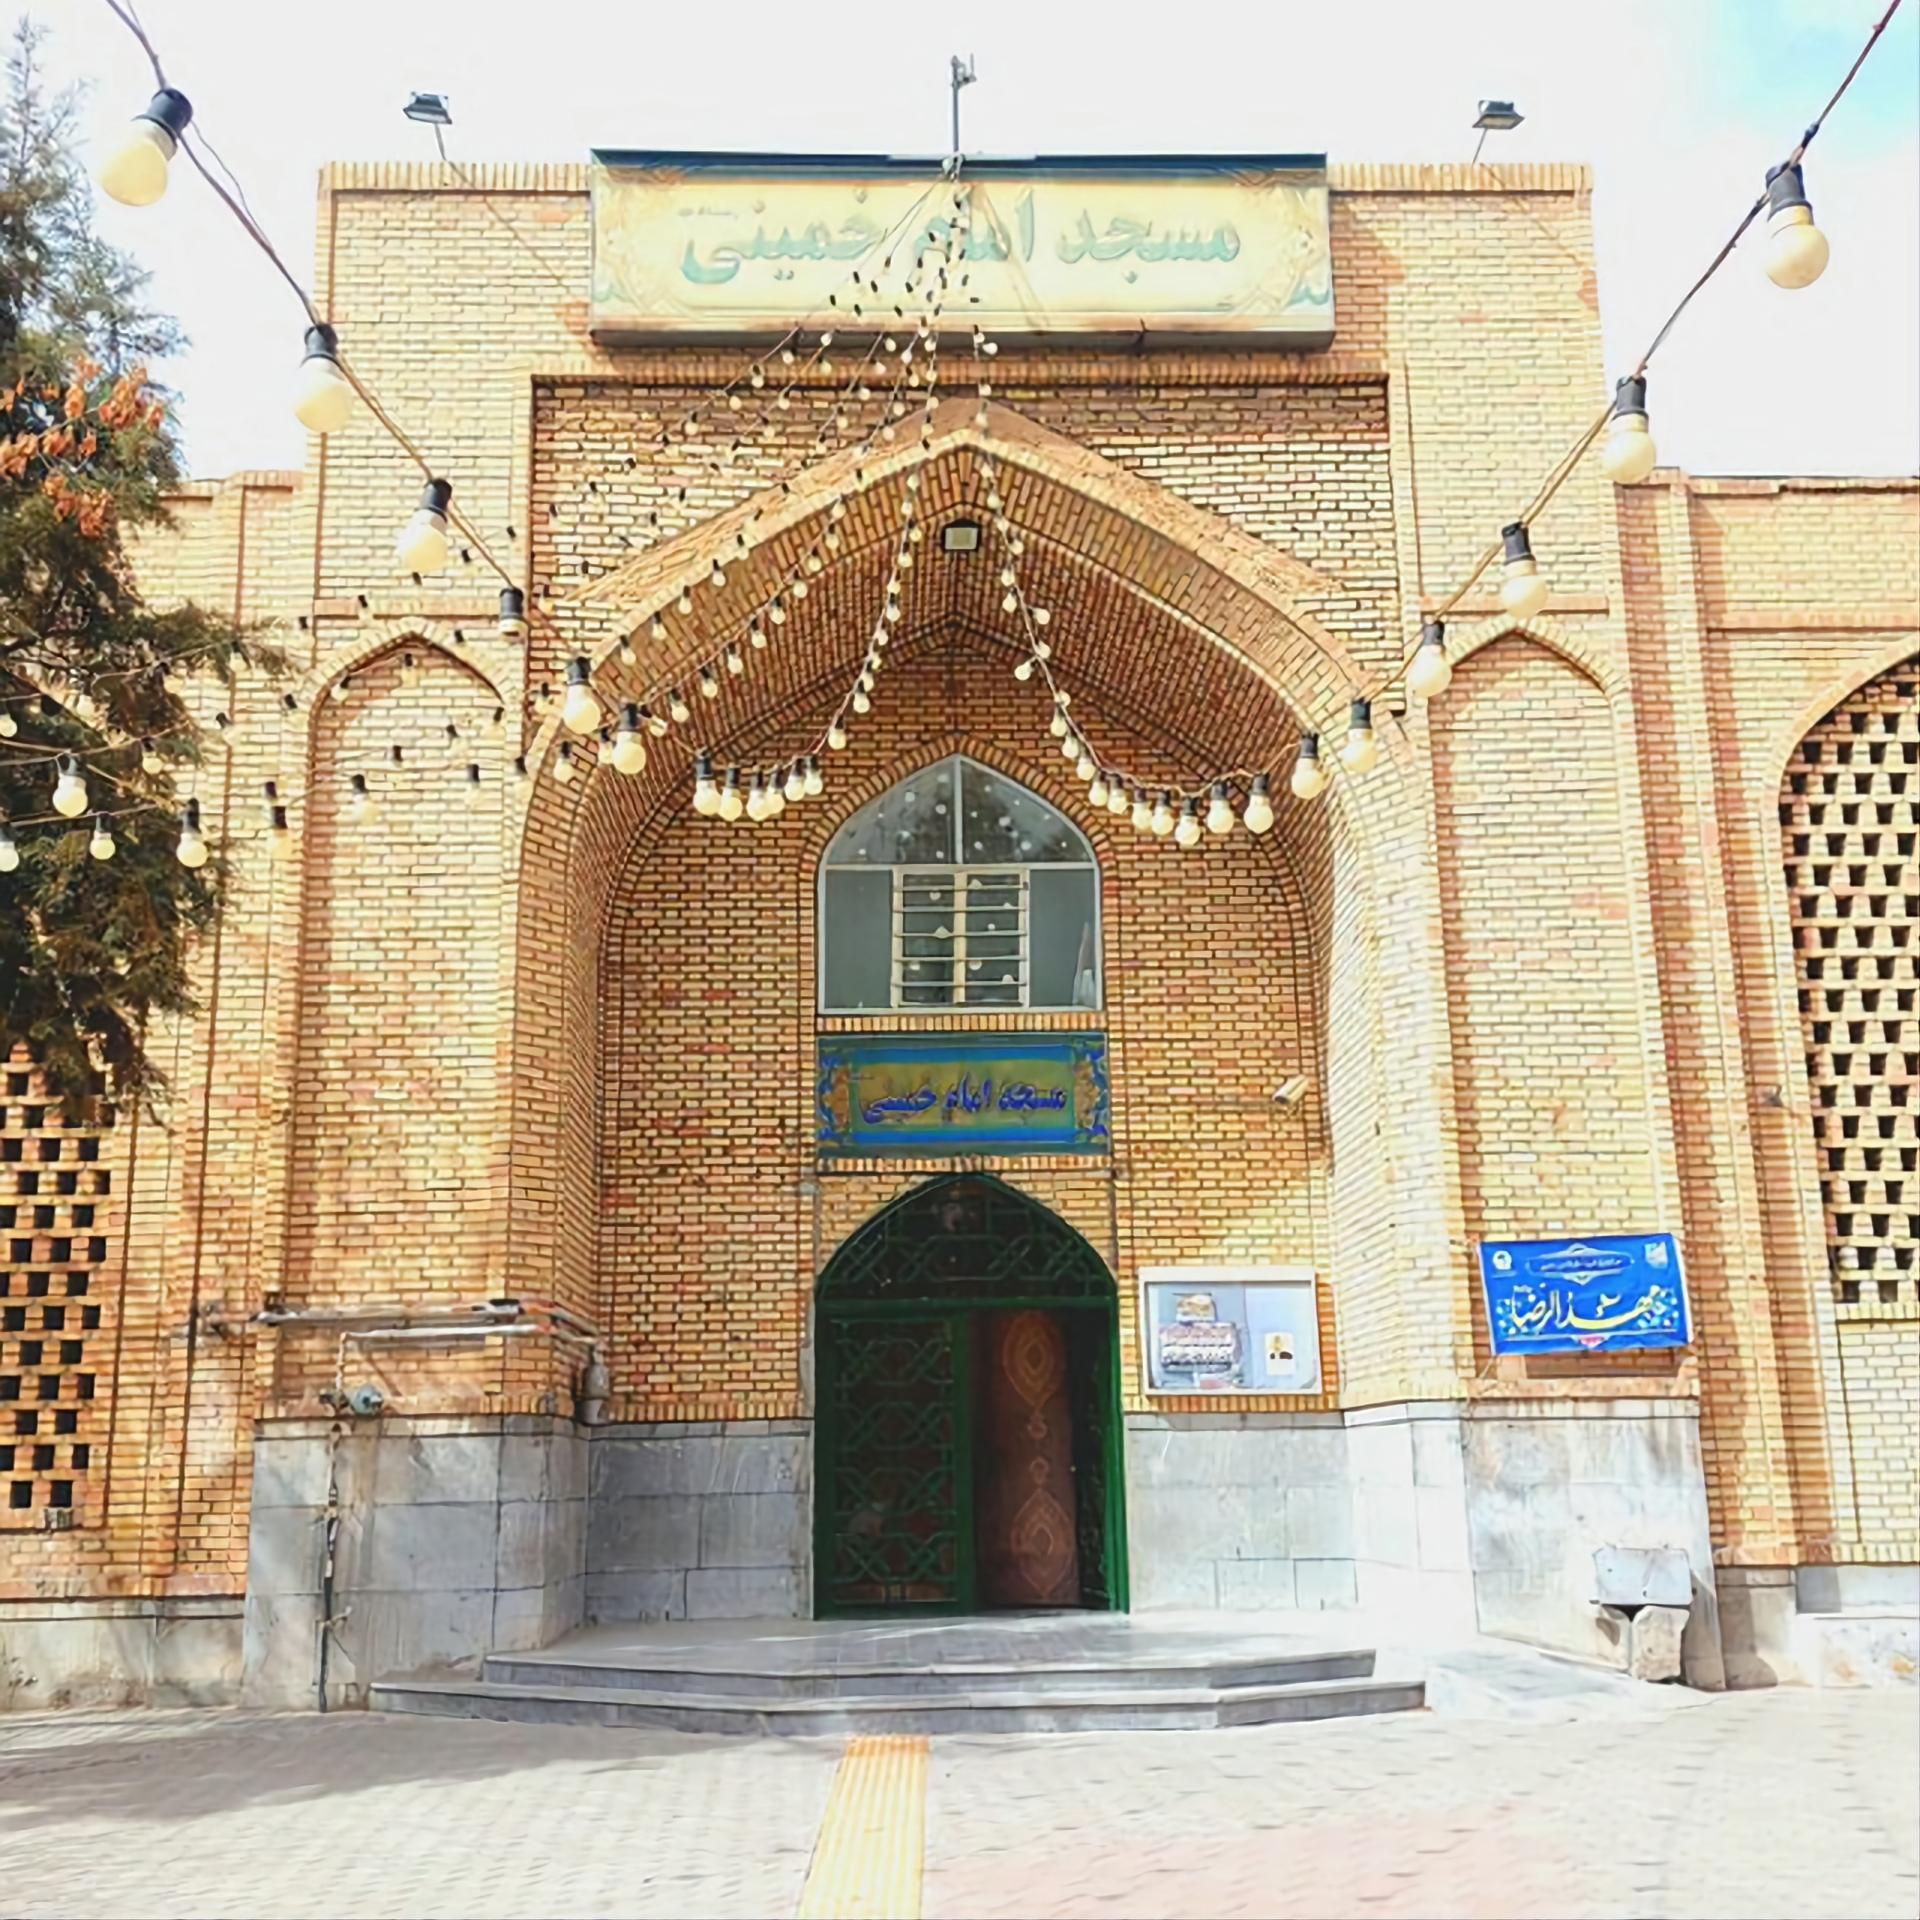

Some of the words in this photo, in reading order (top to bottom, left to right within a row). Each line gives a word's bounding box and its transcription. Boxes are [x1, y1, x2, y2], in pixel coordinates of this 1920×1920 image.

[681, 190, 884, 285] خمینی
[1056, 208, 1241, 283] مسجد
[943, 1072, 992, 1122] امام
[998, 1082, 1067, 1123] مسجد
